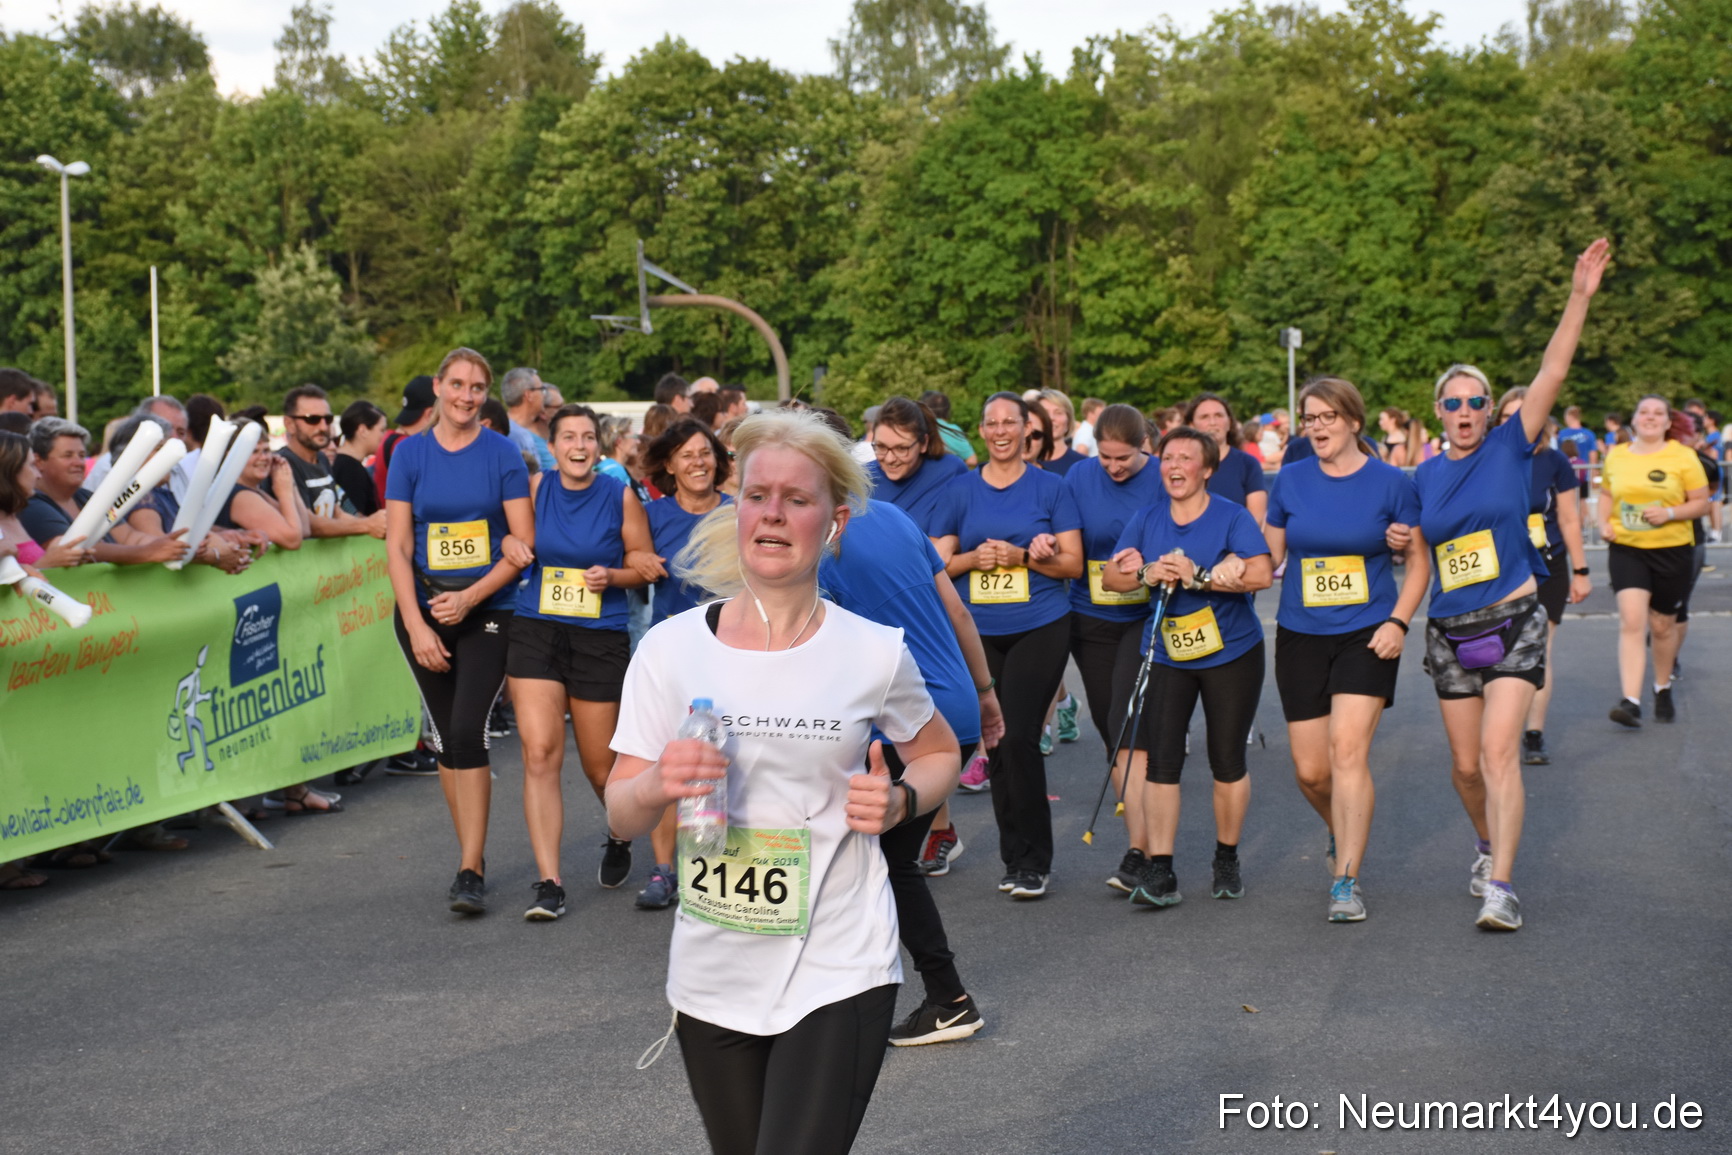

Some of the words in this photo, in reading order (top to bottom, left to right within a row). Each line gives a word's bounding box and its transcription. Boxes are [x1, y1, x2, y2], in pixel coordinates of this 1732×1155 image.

[113, 480, 141, 509] UMS
[440, 538, 475, 557] 856
[1449, 551, 1481, 575] 852
[980, 573, 1014, 590] 872
[1316, 573, 1352, 592] 864
[552, 585, 585, 603] 861
[241, 614, 275, 638] Fischer
[1171, 628, 1206, 649] 854
[209, 643, 326, 741] firmenlauf
[720, 715, 842, 731] SCHWARZ
[219, 723, 272, 761] neumarkt
[788, 733, 842, 742] SYSTEME
[773, 857, 800, 866] 2019
[690, 856, 788, 905] 2146
[698, 893, 732, 910] Krauser
[735, 903, 780, 916] Caroline
